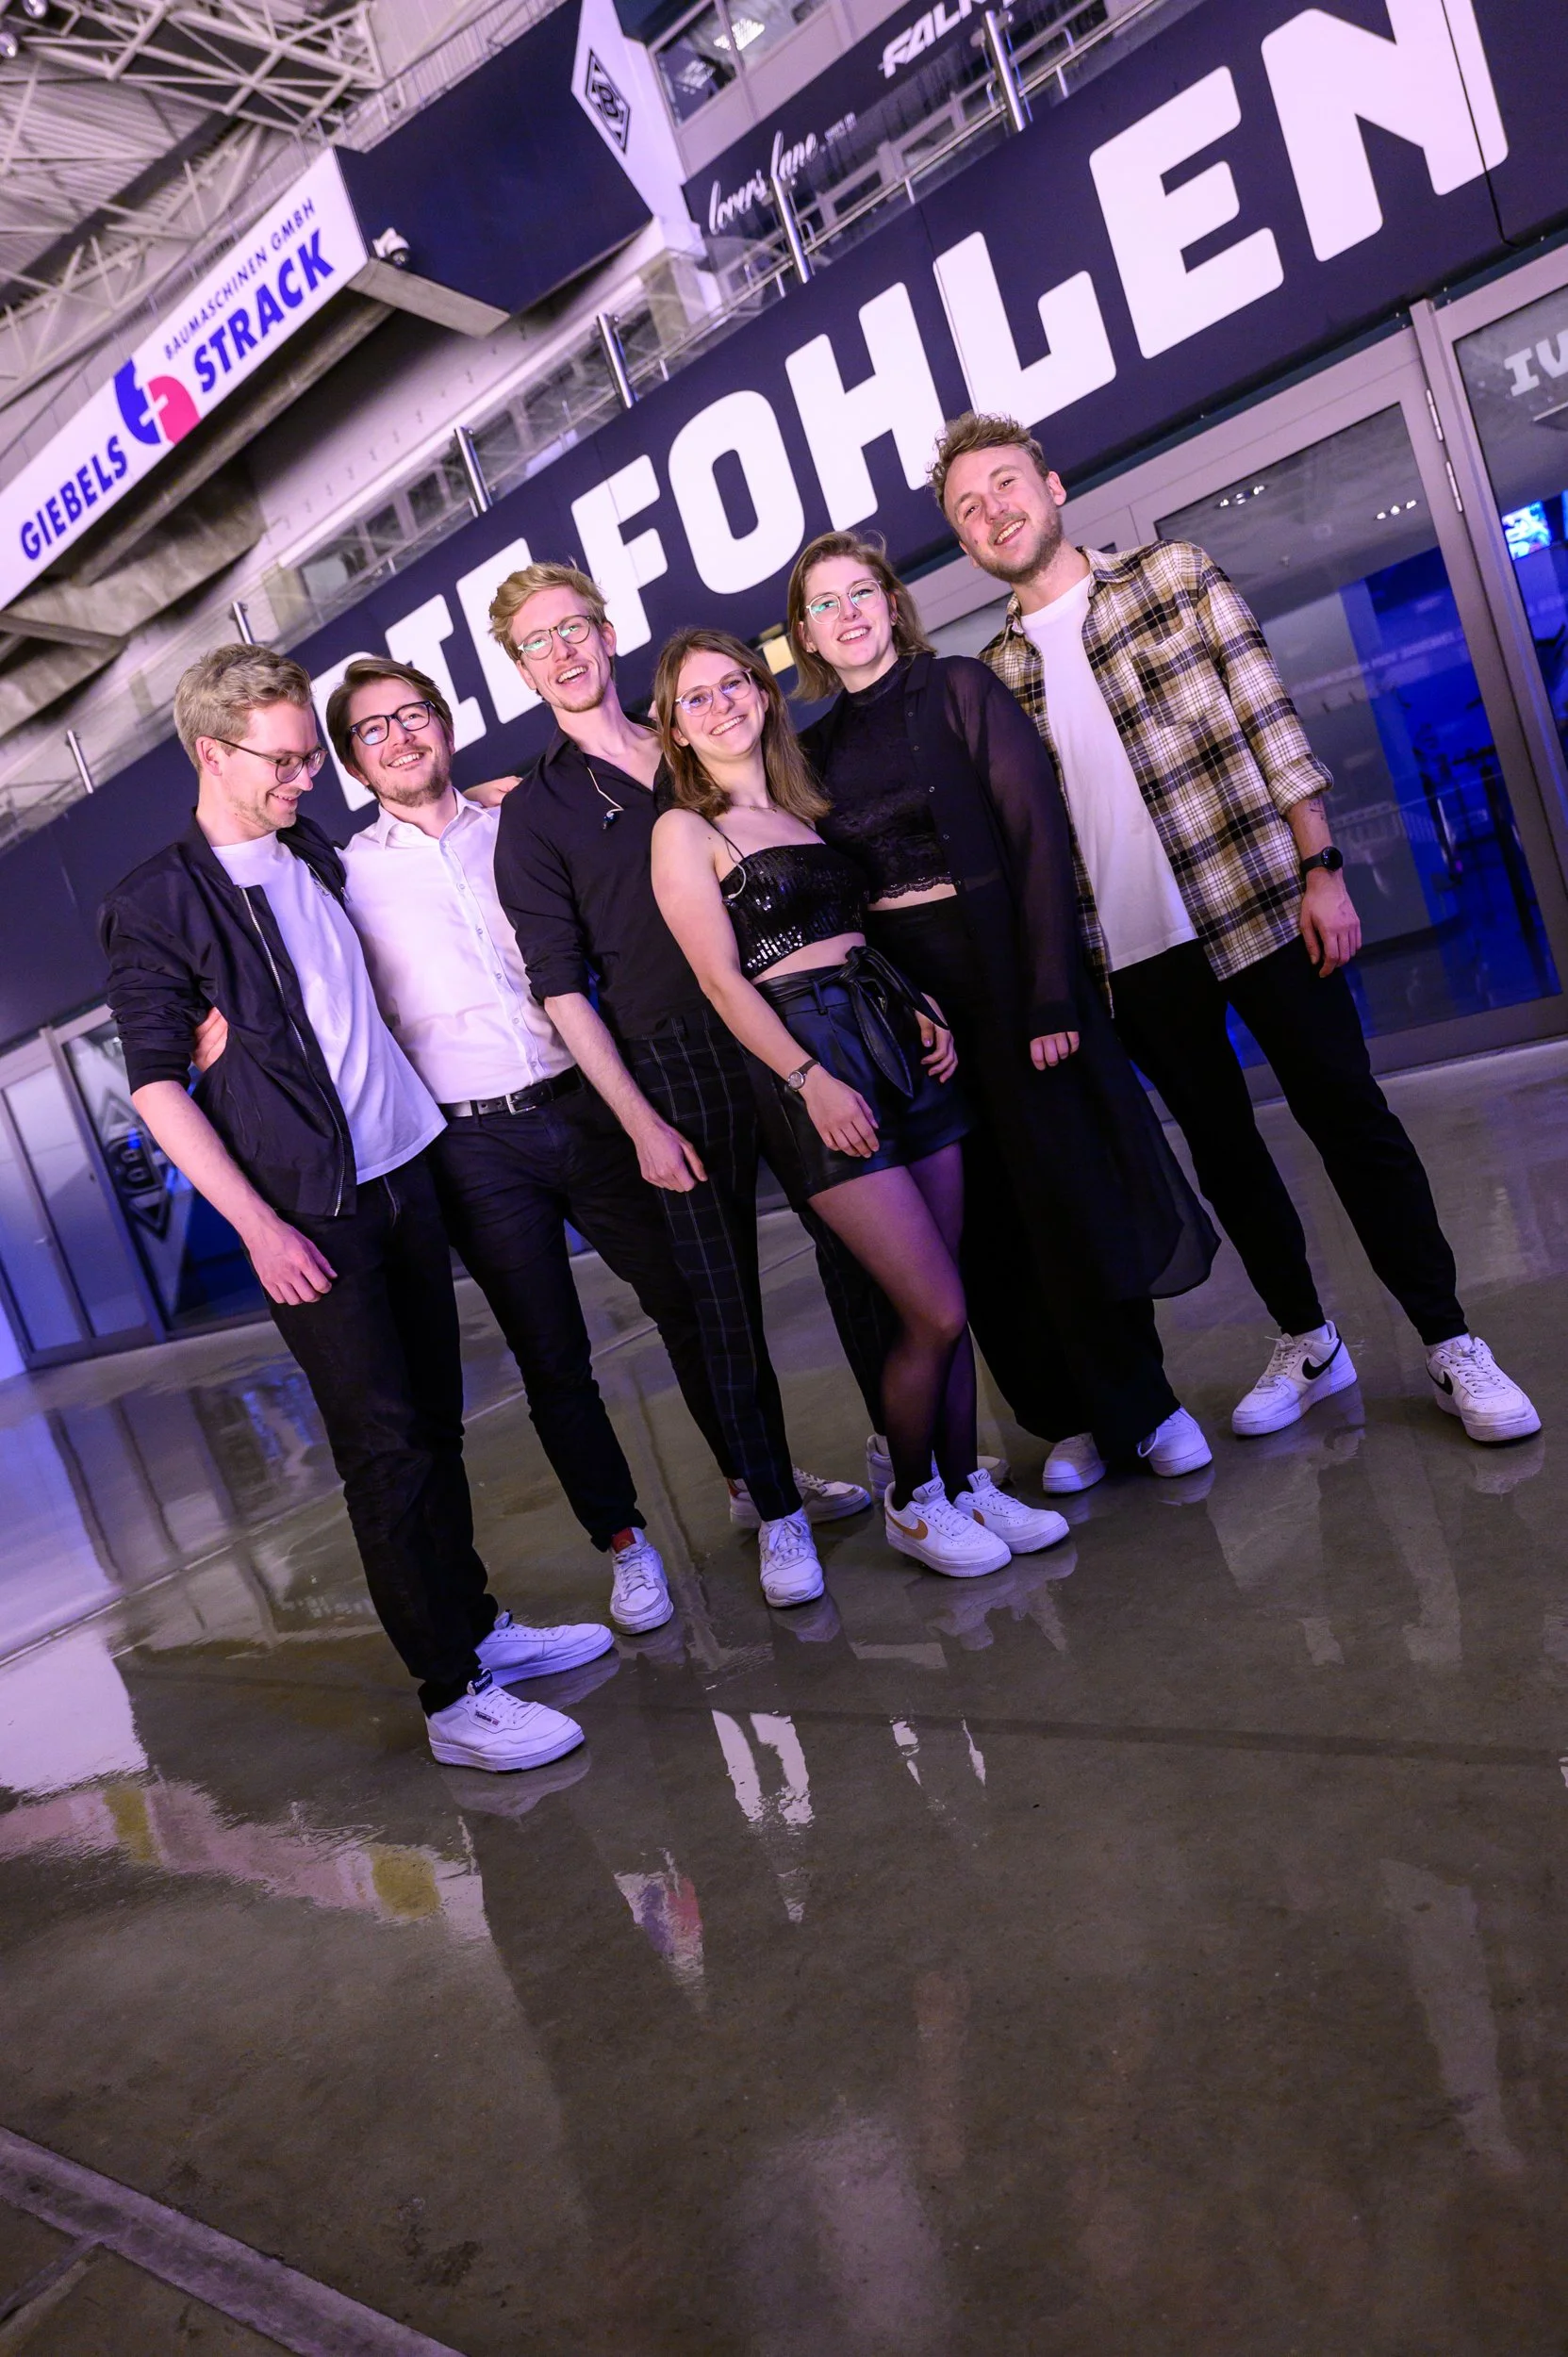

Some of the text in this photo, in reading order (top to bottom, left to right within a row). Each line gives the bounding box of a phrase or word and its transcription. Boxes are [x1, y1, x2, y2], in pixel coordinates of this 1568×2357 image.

[164, 197, 315, 360] BAUMASCHINEN GMBH
[194, 228, 335, 393] STRACK
[570, 0, 1509, 657] FOHLEN
[21, 436, 127, 560] GIEBELS
